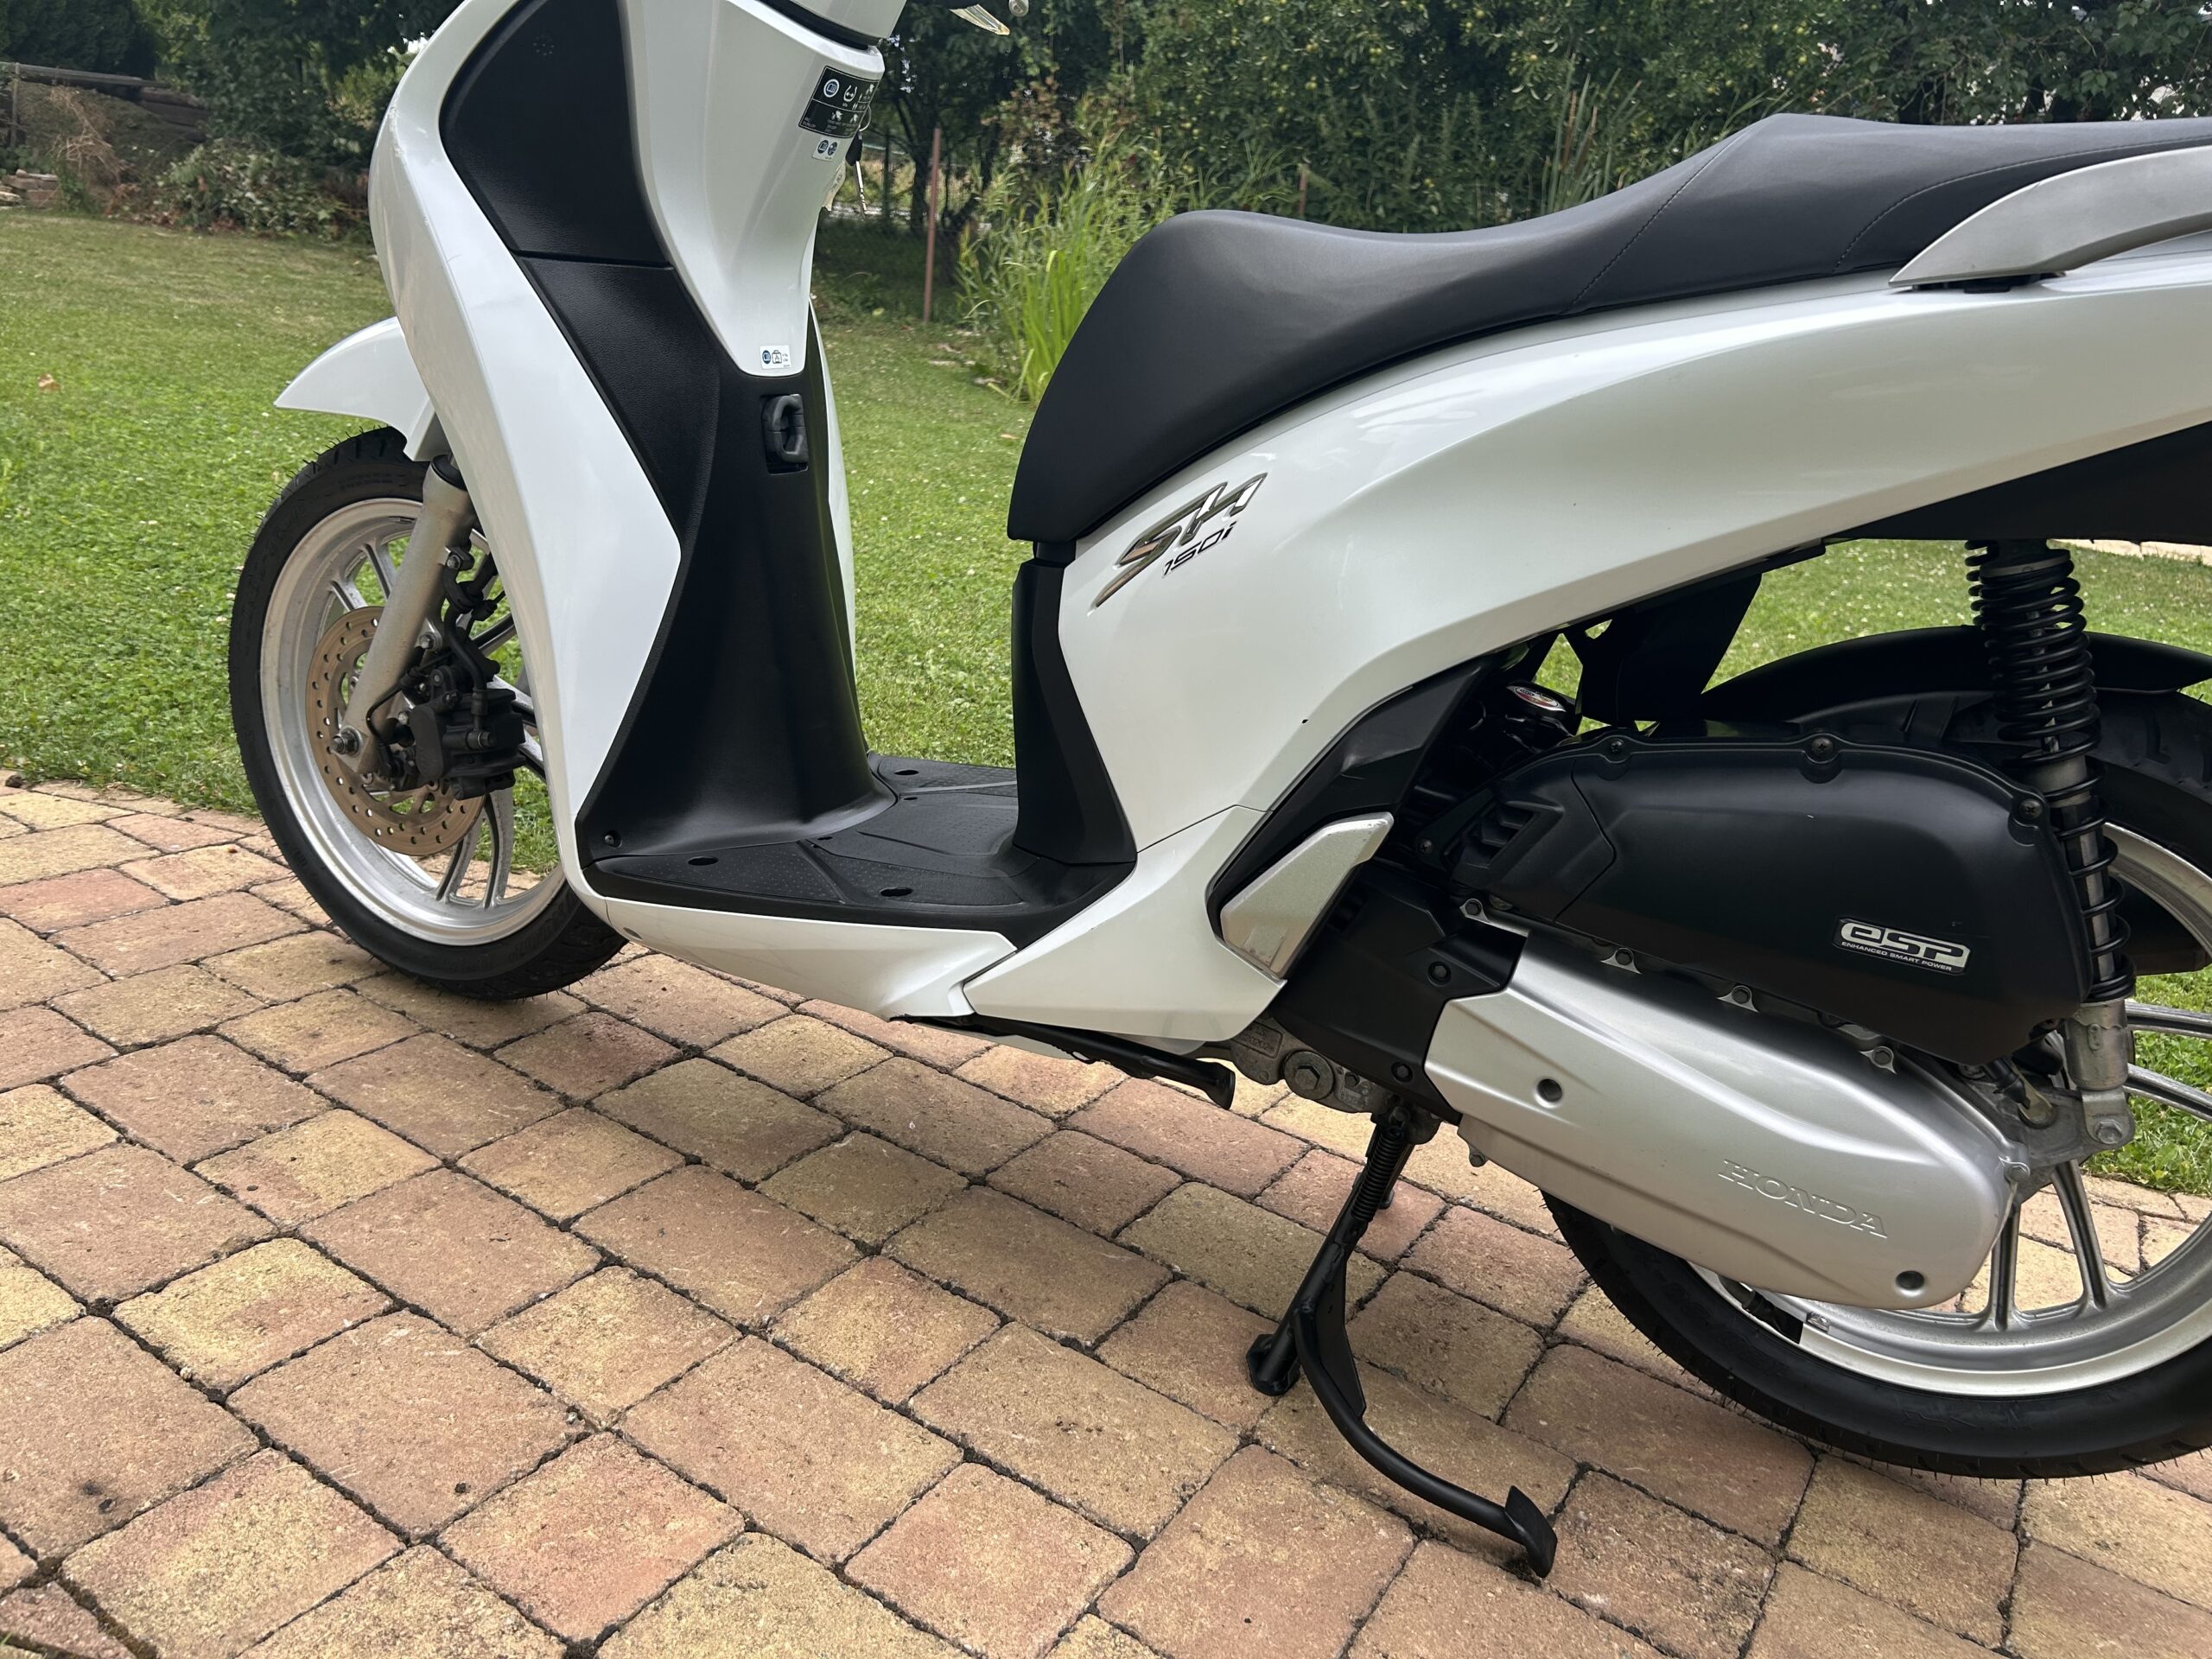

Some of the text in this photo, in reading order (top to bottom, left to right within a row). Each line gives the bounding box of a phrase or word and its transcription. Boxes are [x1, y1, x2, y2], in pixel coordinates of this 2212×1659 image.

[1091, 473, 1268, 608] SH
[1163, 521, 1237, 576] 150i
[1841, 941, 1953, 971] ENHANCED SMART POWER
[1718, 1159, 1888, 1238] HONDA
